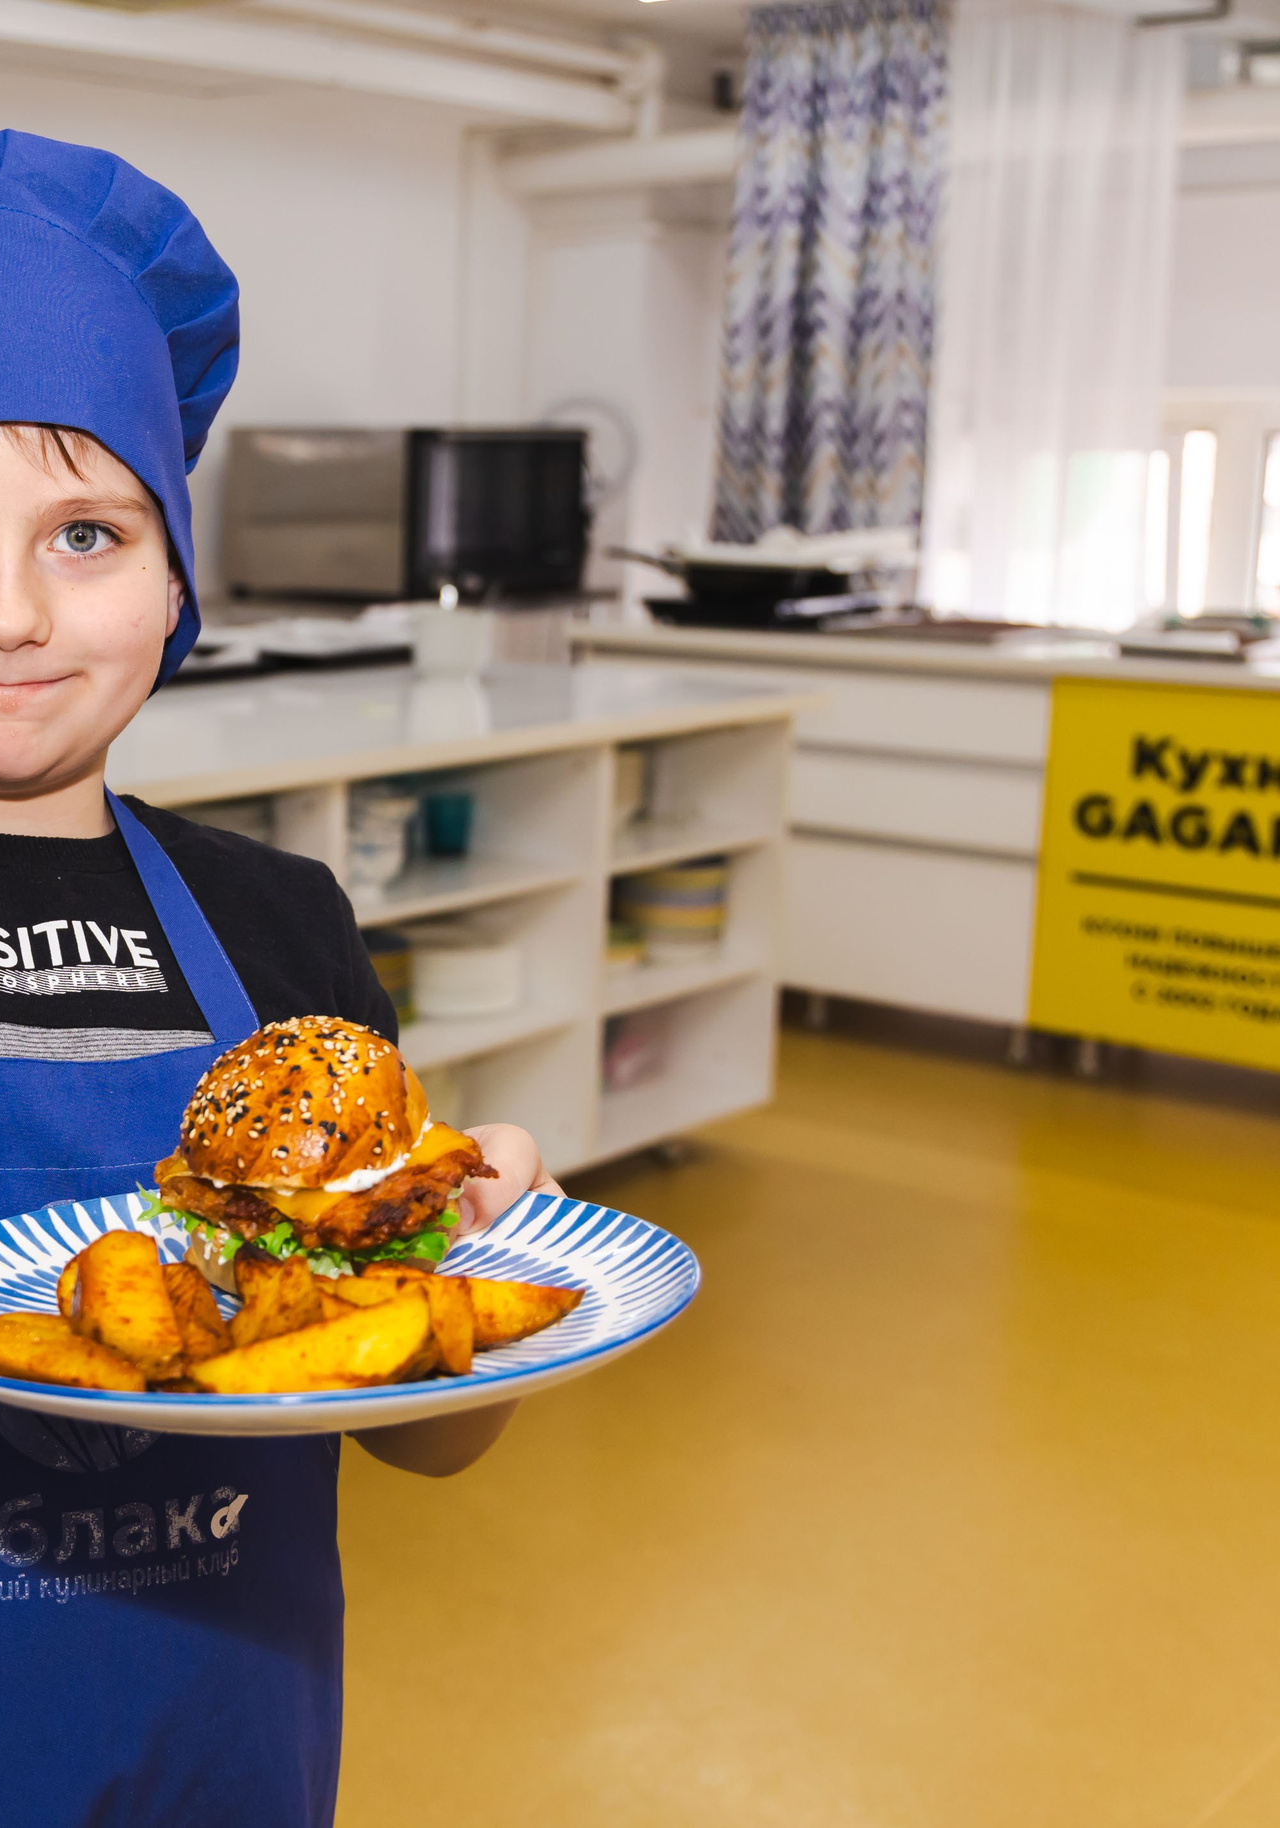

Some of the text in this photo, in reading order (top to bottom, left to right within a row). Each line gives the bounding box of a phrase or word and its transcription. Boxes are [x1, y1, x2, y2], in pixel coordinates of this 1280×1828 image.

[1074, 794, 1280, 861] GAGA
[39, 1555, 190, 1604] кулинарный
[197, 1540, 239, 1577] клуб
